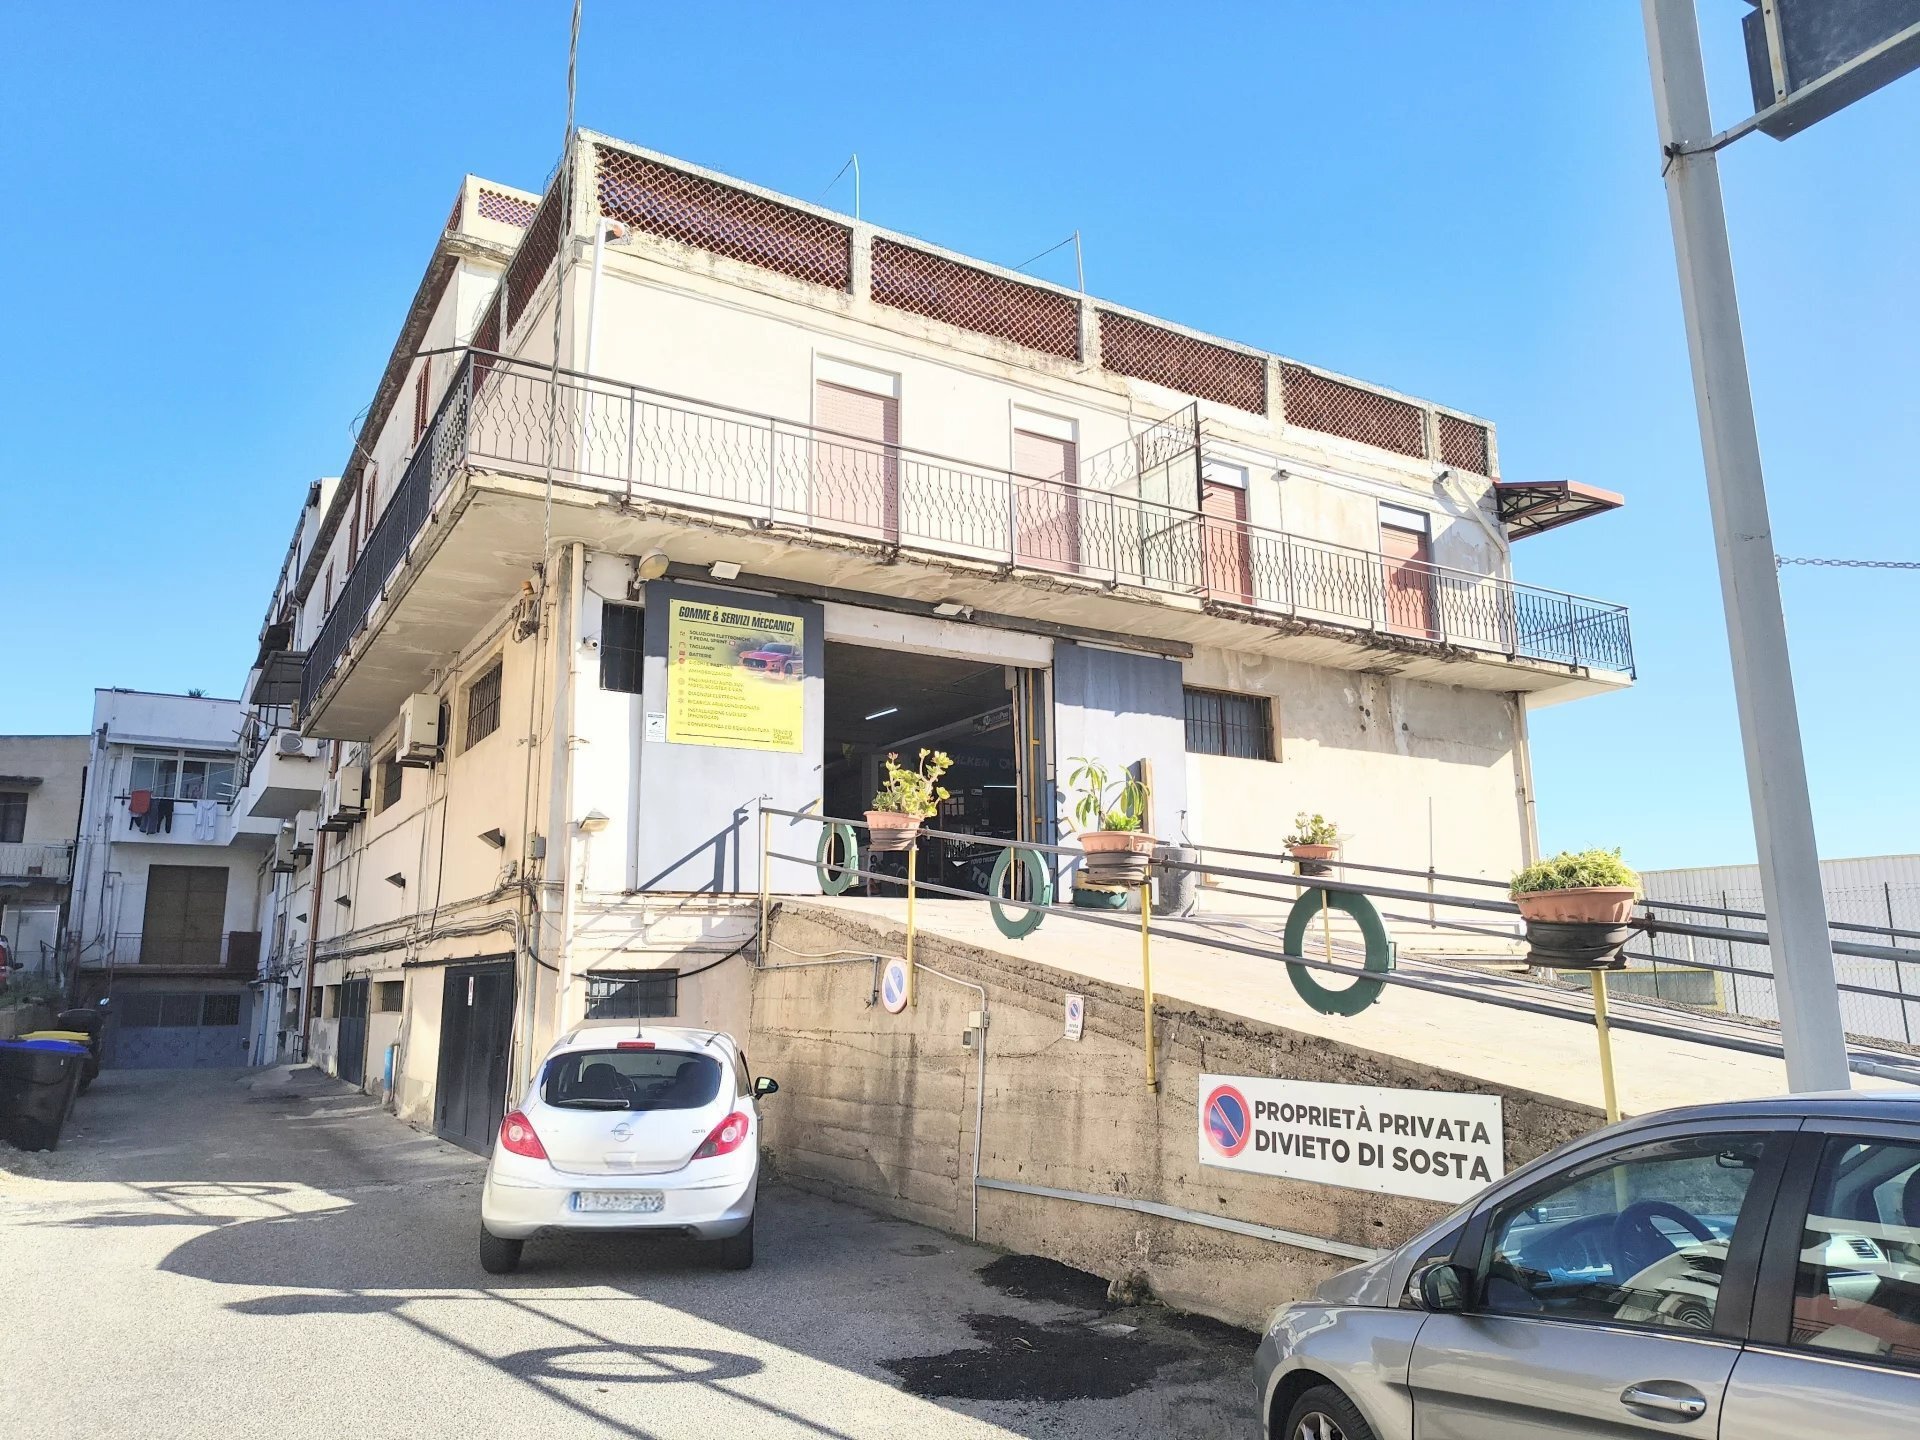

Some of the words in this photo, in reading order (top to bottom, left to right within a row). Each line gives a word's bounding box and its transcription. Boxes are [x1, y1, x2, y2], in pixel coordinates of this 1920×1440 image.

[679, 606, 711, 621] GOMME
[713, 611, 719, 621] &
[721, 612, 751, 626] SERVIZI
[752, 616, 795, 632] MECCANICI
[689, 630, 716, 639] SOLUZIONI
[1255, 1100, 1373, 1132] PROPRIETÀ
[1379, 1112, 1491, 1145] PRIVATA
[1255, 1129, 1351, 1163] DIVIETO
[1358, 1142, 1384, 1169] DI
[1392, 1146, 1492, 1183] SOSTA
